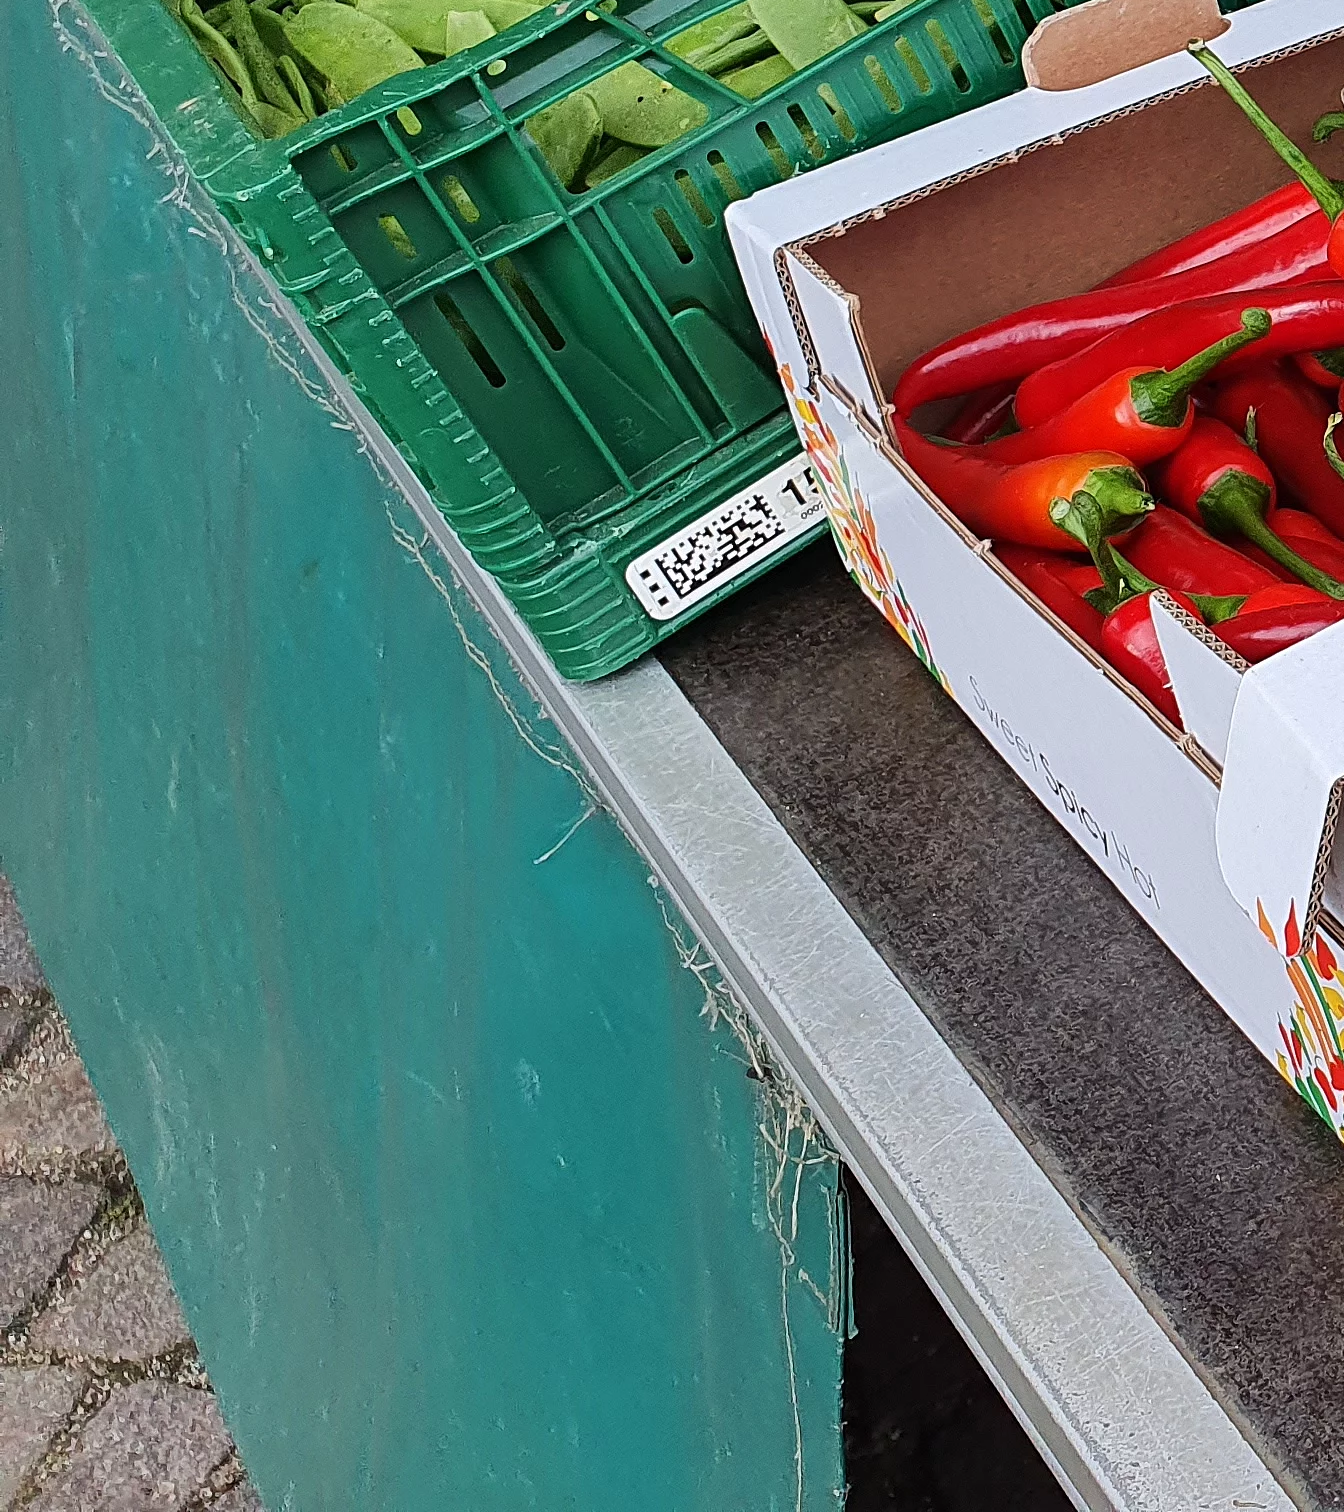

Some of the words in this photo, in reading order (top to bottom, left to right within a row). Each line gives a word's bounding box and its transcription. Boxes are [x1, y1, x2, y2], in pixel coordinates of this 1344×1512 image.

[969, 675, 1037, 772] Sweet
[1039, 753, 1109, 858] Spicy
[1111, 831, 1160, 910] Hot
